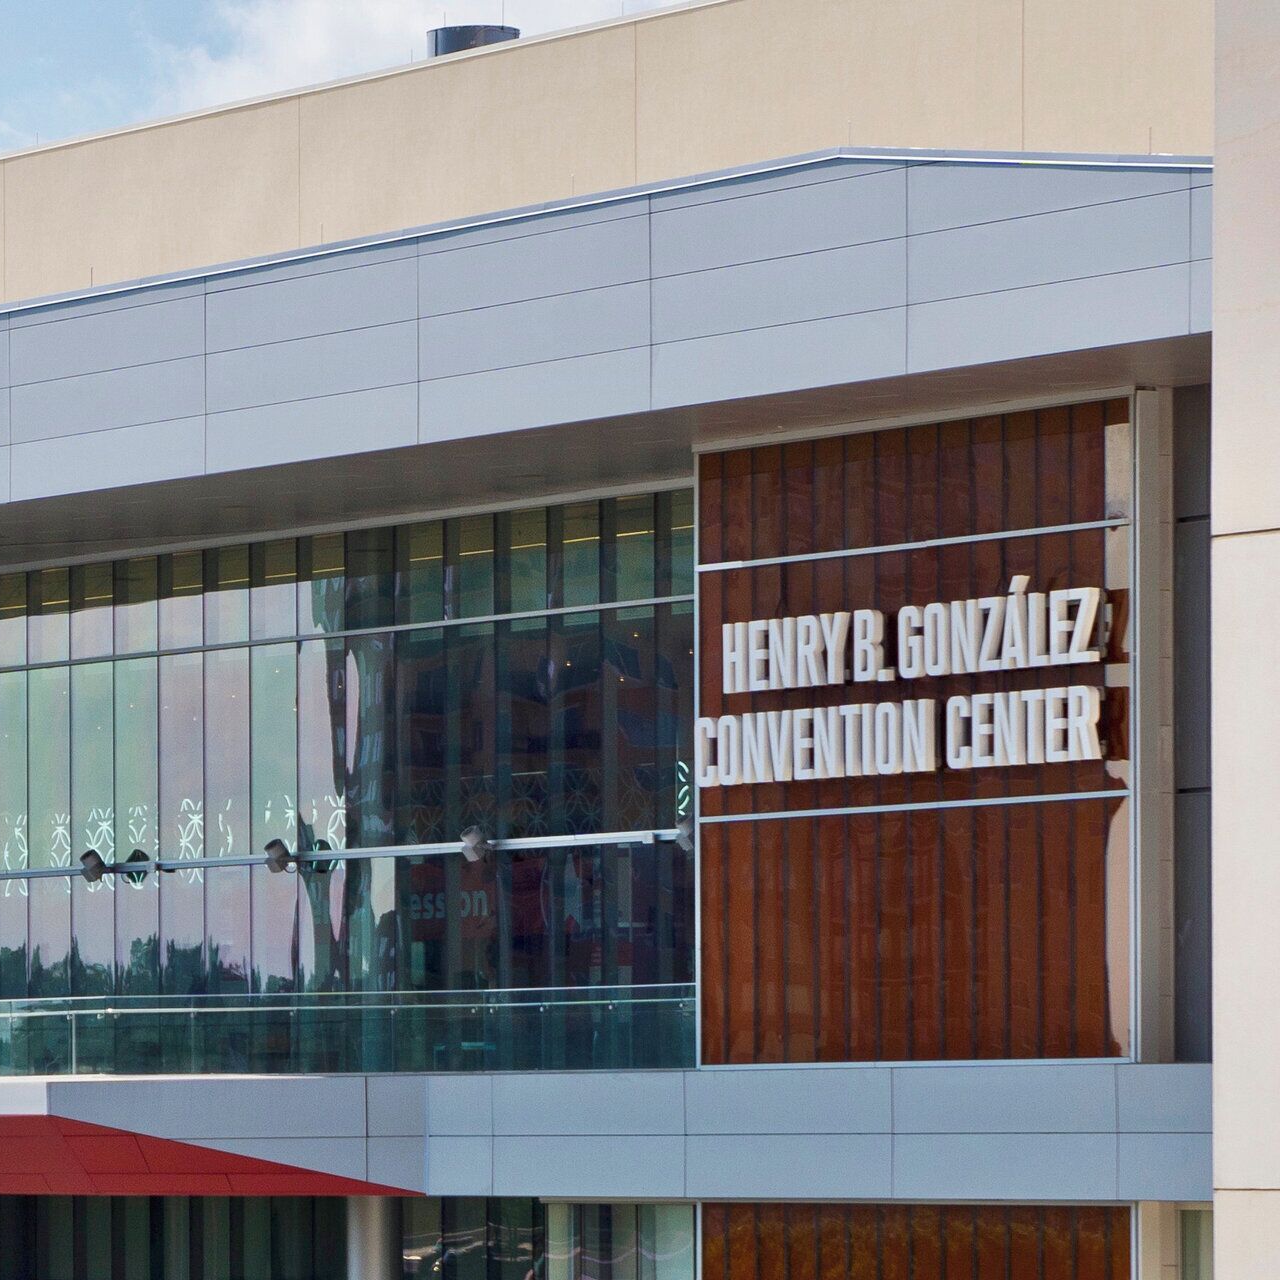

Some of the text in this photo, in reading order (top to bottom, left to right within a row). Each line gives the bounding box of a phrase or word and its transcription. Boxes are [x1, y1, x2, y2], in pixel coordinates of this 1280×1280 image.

[722, 575, 1103, 694] HENRY B. GONZÁLEZ
[694, 685, 1103, 788] CONVENTION CENTER
